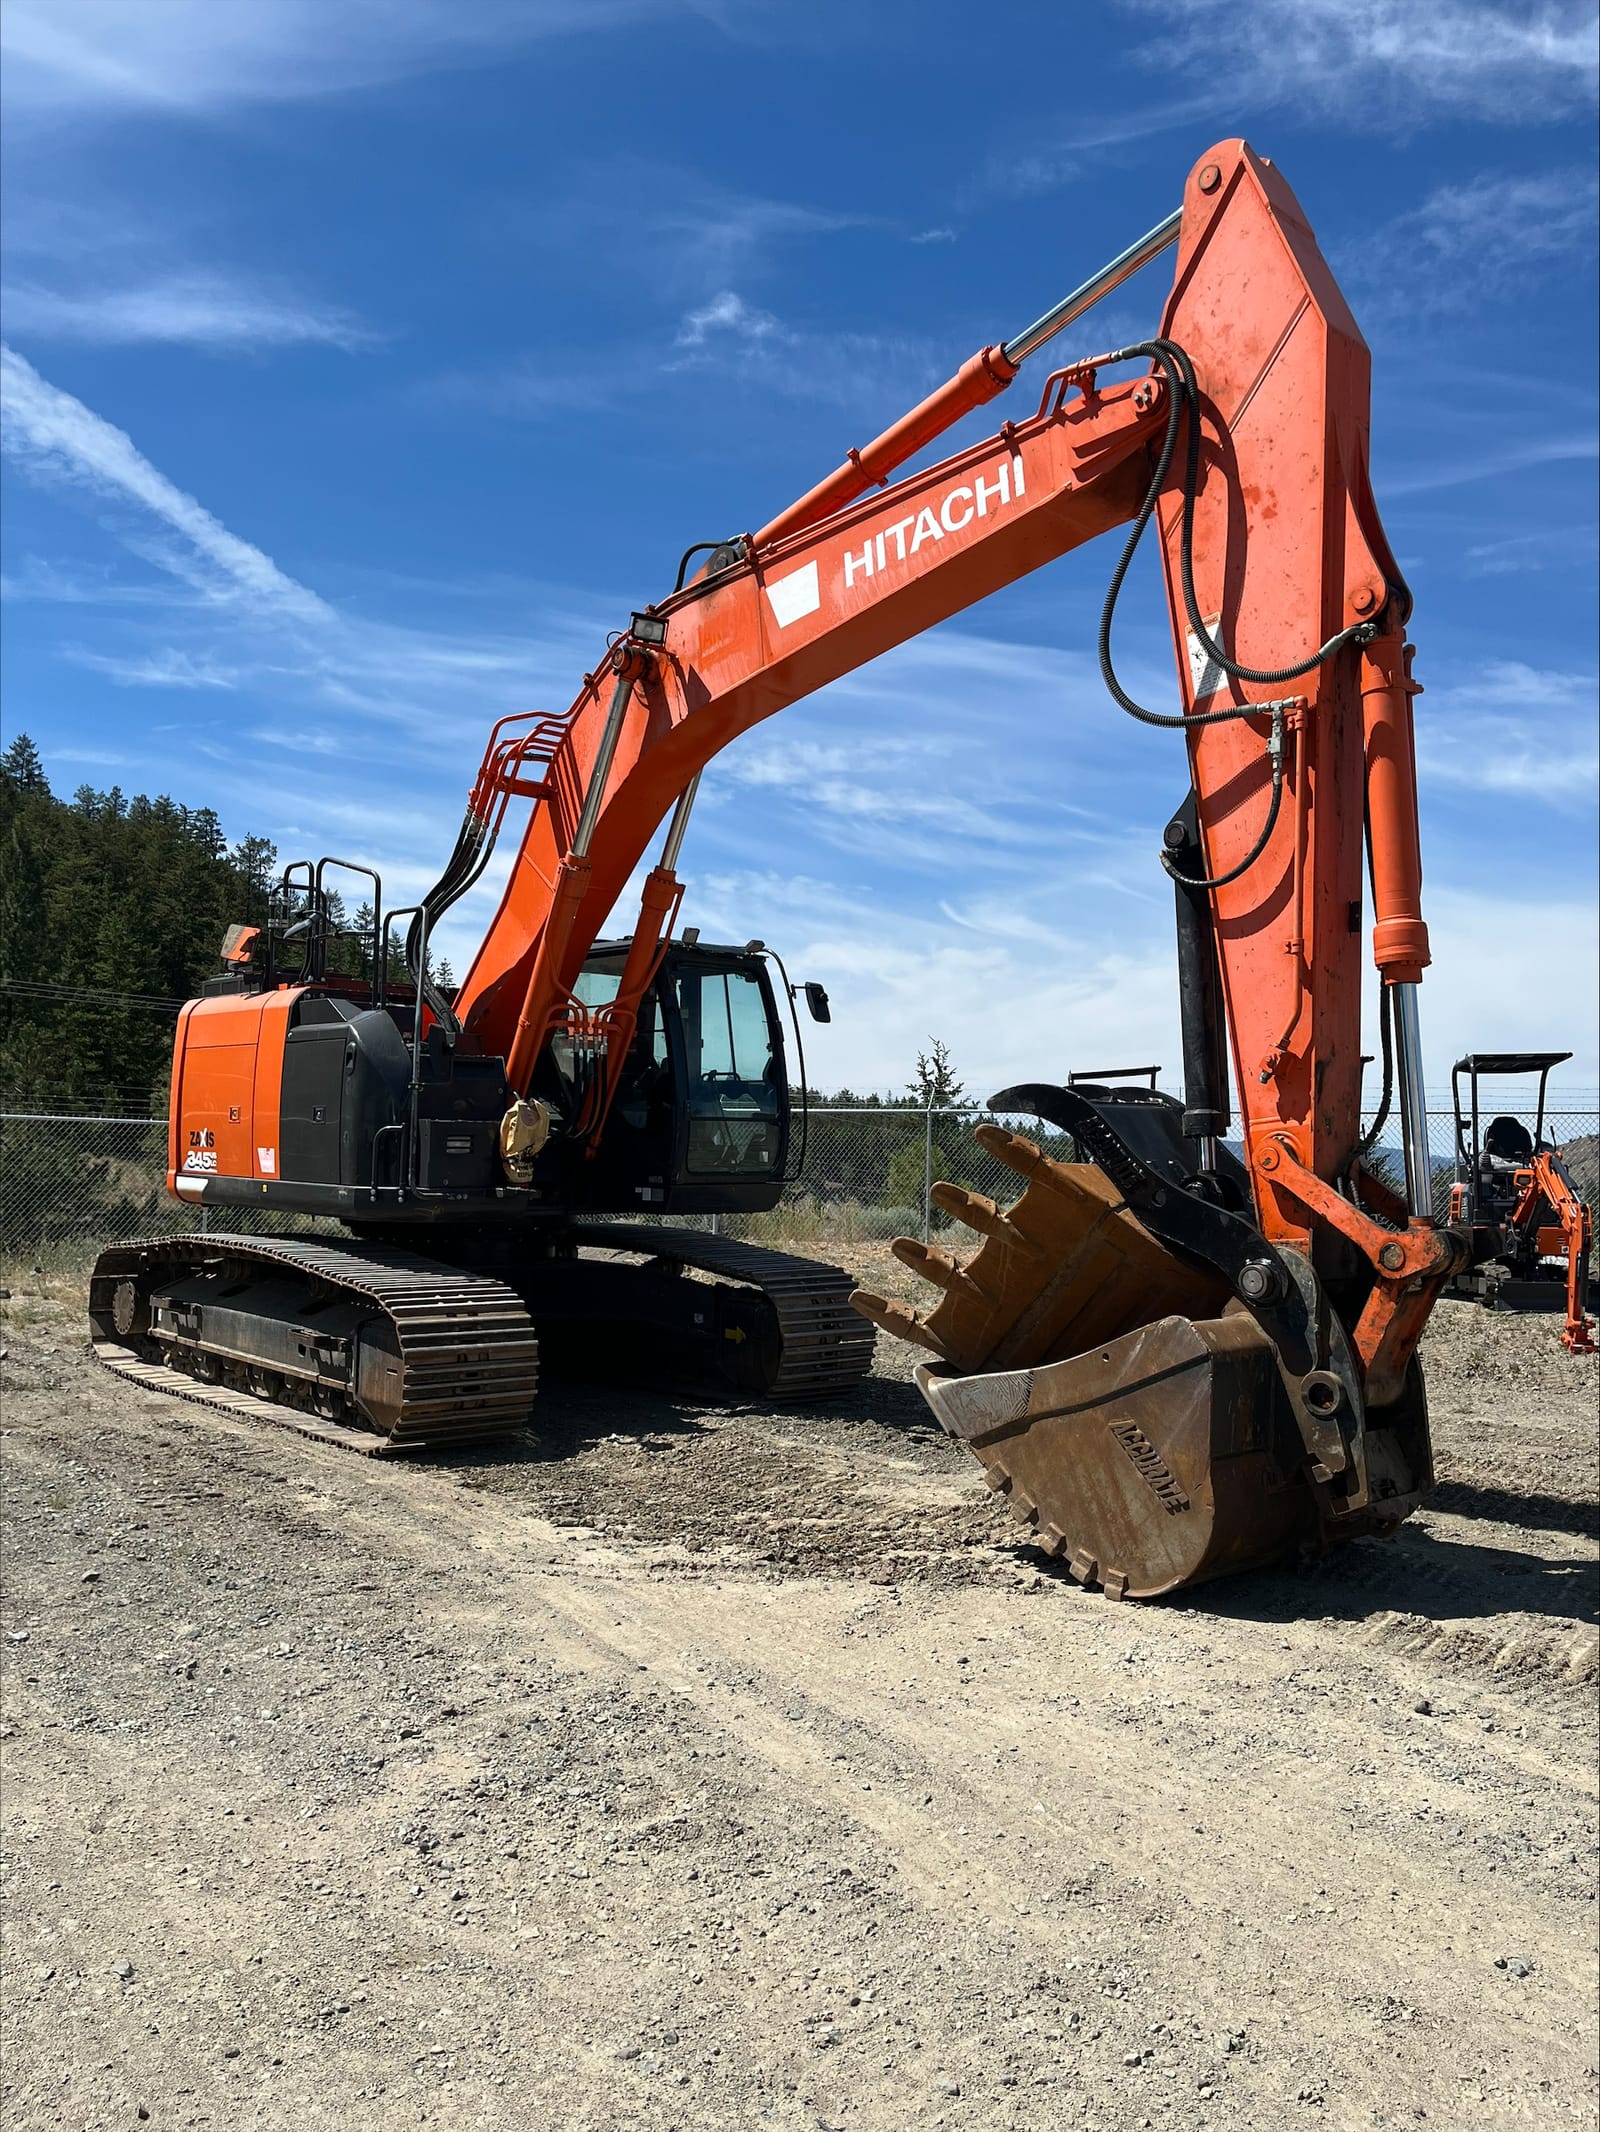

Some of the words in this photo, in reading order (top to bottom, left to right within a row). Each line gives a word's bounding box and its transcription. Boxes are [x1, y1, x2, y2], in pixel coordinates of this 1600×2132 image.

[843, 454, 1026, 588] HITACHI
[187, 1150, 211, 1168] 345
[190, 1128, 215, 1147] ZAXIS
[1108, 1417, 1191, 1516] ACCURATE
